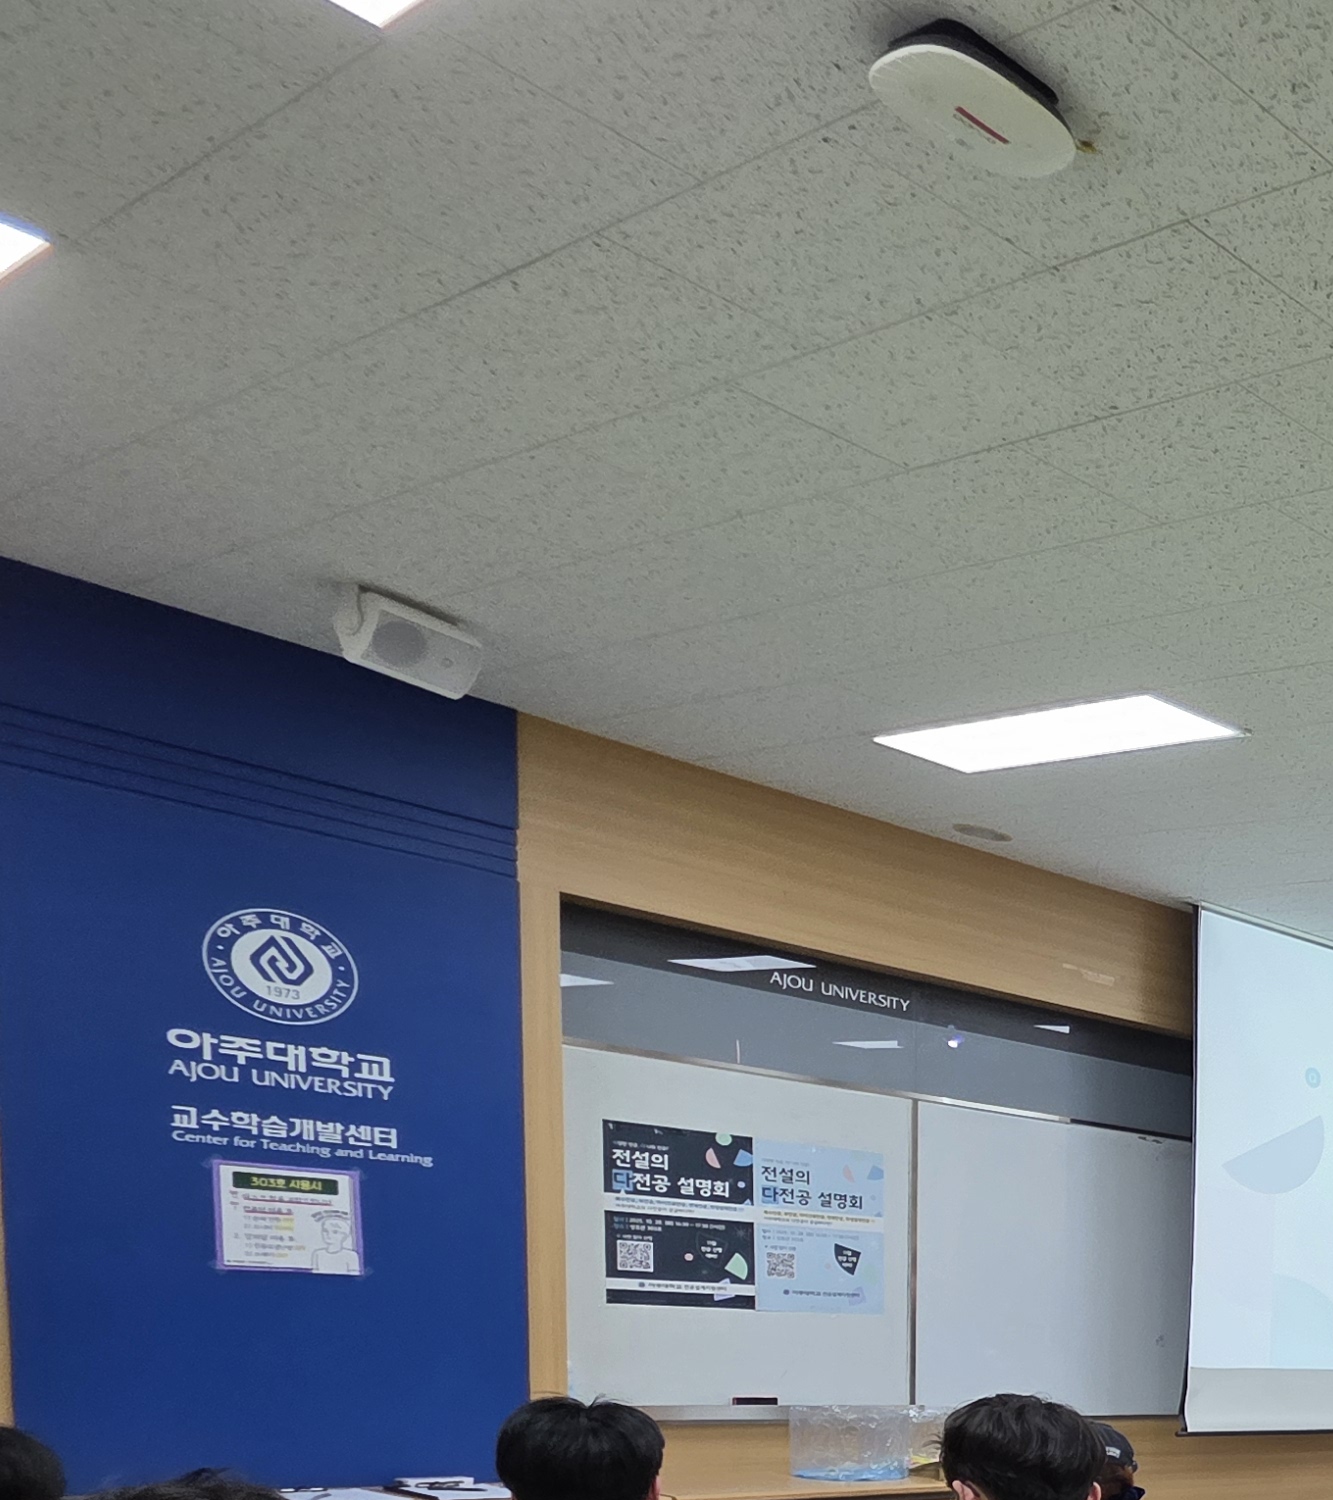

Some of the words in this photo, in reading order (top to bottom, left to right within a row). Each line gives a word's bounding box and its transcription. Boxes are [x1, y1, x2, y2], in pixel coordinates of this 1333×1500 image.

[217, 913, 342, 959] 아주대학교
[210, 957, 247, 999] AJOU
[253, 979, 351, 1020] UNIVERSITY
[266, 985, 300, 1000] 1973
[769, 970, 813, 994] AJOU
[821, 981, 910, 1013] UNIVERSITY
[166, 1028, 395, 1083] 아주대학교
[169, 1059, 239, 1082] AJOU
[251, 1068, 393, 1100] UNIVERSITY
[171, 1105, 398, 1148] 교수학습개발센터
[172, 1130, 229, 1145] Center
[233, 1136, 257, 1148] for
[260, 1138, 331, 1158] Teaching
[334, 1145, 364, 1159] and
[368, 1150, 433, 1167] Learning
[612, 1149, 669, 1171] 전설의
[613, 1171, 671, 1193] 다전공
[677, 1177, 730, 1197] 설명회
[761, 1166, 810, 1185] 전설의
[762, 1186, 812, 1206] 다전공
[818, 1192, 862, 1210] 설명회
